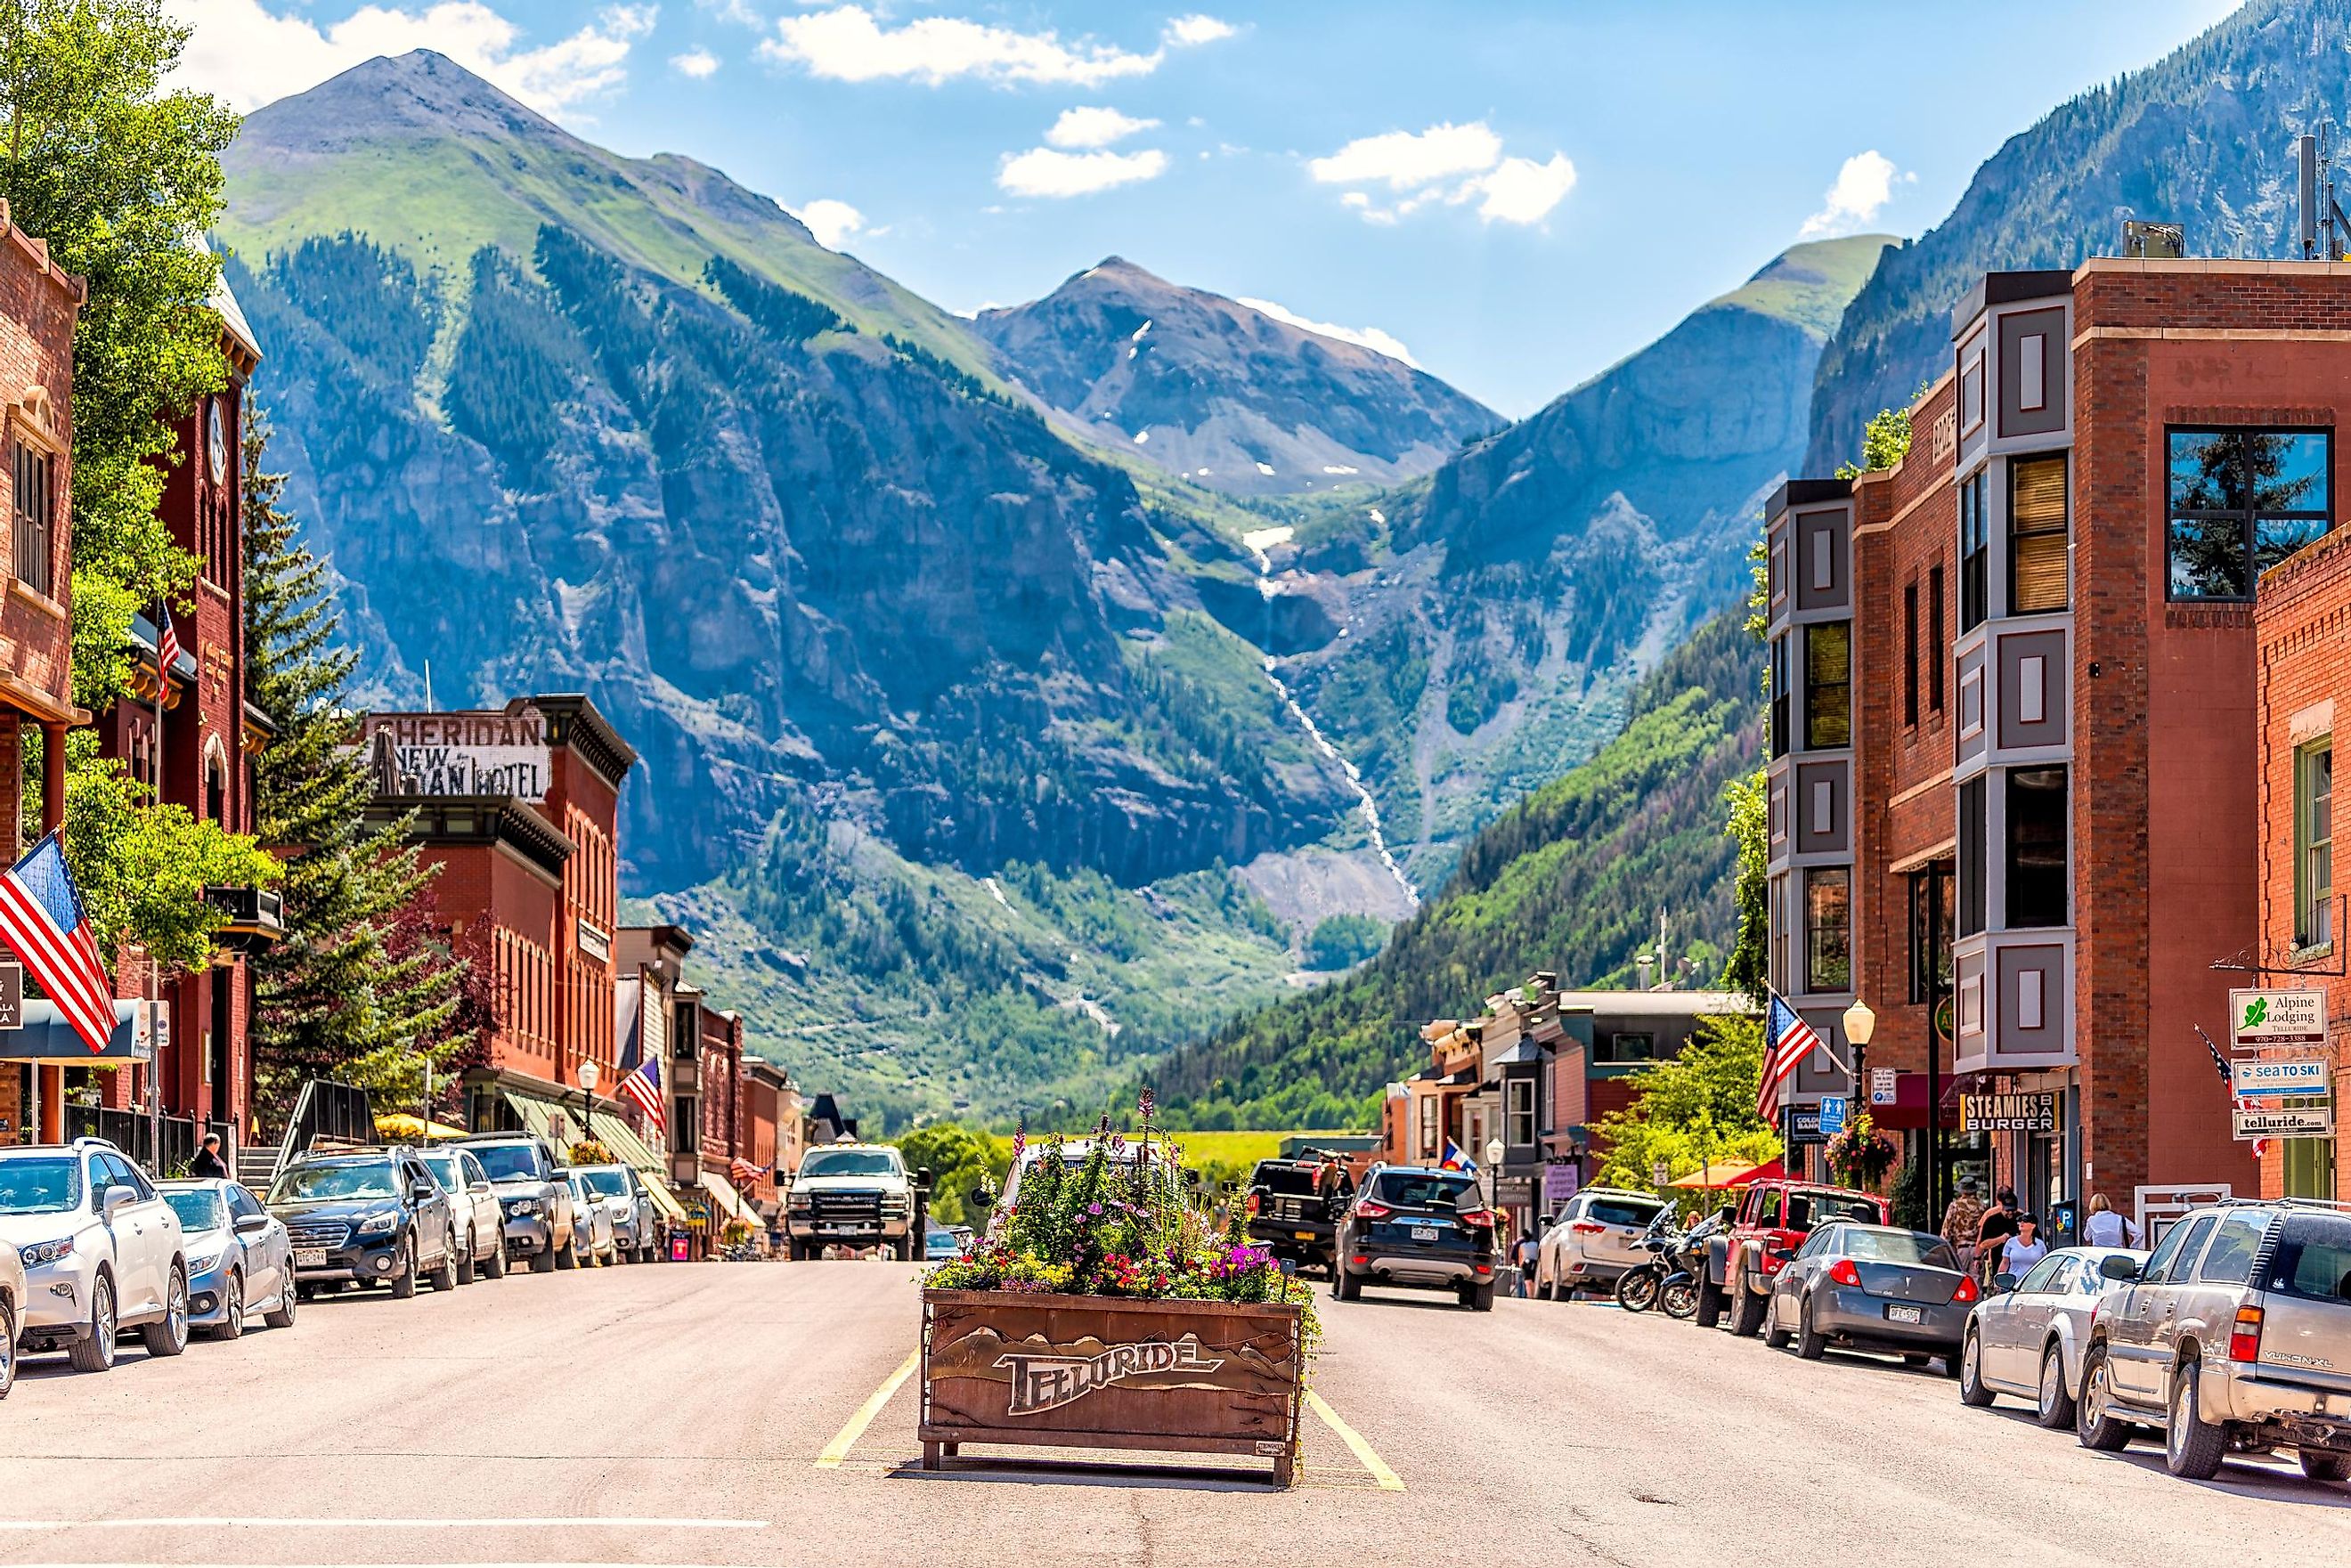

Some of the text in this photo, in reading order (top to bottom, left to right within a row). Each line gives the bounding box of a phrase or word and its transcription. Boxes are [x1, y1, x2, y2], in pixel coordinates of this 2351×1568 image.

[2275, 995, 2314, 1011] Alpine
[2266, 1010, 2315, 1025] Lodging
[2271, 1025, 2308, 1033] TELLURIDE
[2255, 1035, 2306, 1043] 970-728-3388
[2256, 1065, 2320, 1077] sea TO SKI
[1966, 1095, 2038, 1118] STEAMIES
[2039, 1094, 2054, 1130] BAR
[1966, 1118, 2053, 1130] BURGER
[2244, 1116, 2323, 1129] telluride.com
[2062, 1211, 2071, 1225] P
[2265, 1351, 2312, 1364] YUKON
[993, 1343, 1224, 1416] TELLURIDE
